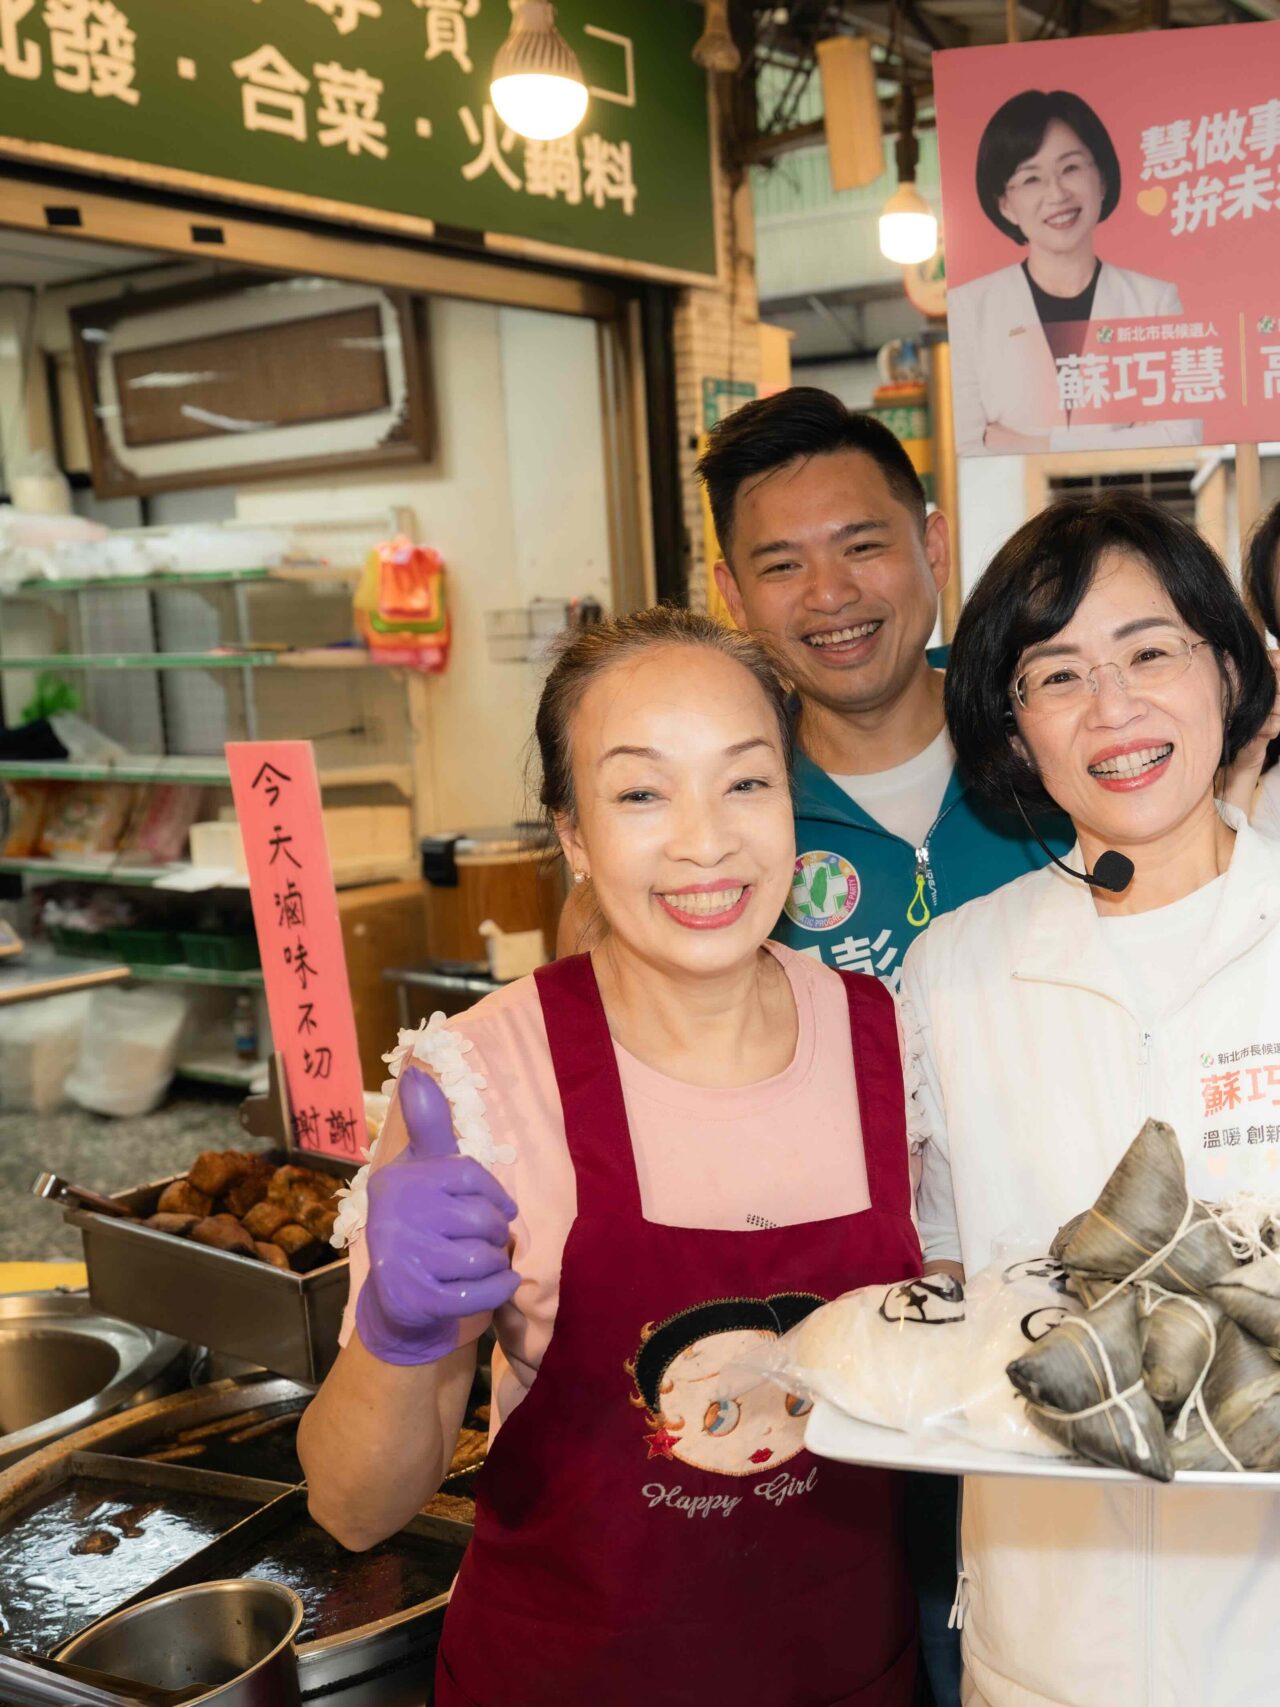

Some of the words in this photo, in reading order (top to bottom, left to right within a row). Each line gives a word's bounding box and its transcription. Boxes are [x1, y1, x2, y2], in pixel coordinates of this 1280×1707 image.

[1117, 323, 1218, 343] 新北市長候選人
[1055, 345, 1227, 411] 蘇巧慧
[641, 1482, 744, 1519] Happy
[753, 1466, 818, 1507] Girl
